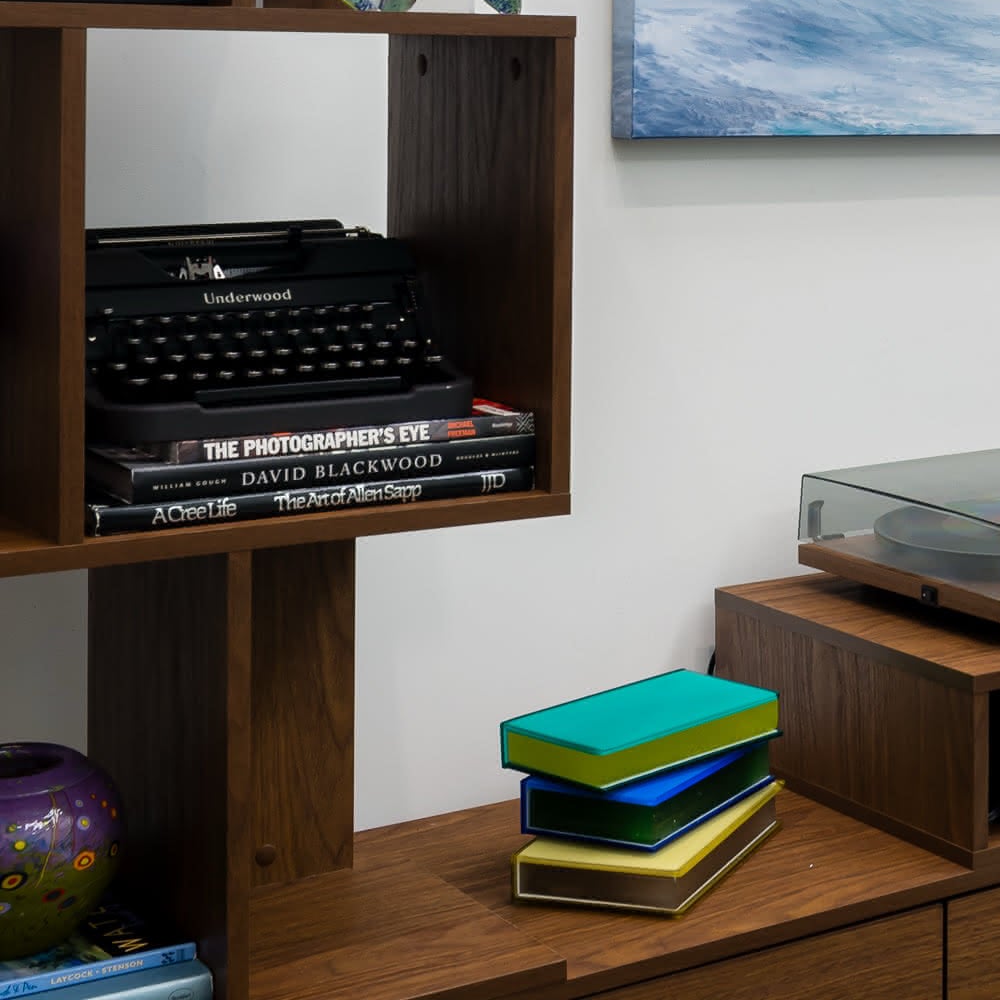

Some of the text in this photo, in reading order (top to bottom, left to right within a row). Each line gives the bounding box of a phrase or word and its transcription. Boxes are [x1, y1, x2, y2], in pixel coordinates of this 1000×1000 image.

[203, 288, 292, 304] Underwood
[203, 423, 431, 461] THE PHOTOGRAPHER'S EYE
[152, 482, 192, 490] WILLIAM
[241, 466, 307, 487] DAVID
[315, 454, 443, 479] BLACKWOOD
[151, 507, 168, 525] A
[167, 504, 207, 523] Cree
[207, 497, 238, 518] Life
[273, 491, 307, 512] The
[306, 492, 331, 509] Art
[330, 488, 348, 505] of
[346, 484, 383, 504] Allen
[383, 484, 423, 504] Sapp
[50, 970, 94, 985] LAYCOCK
[101, 960, 144, 975] STENSON
